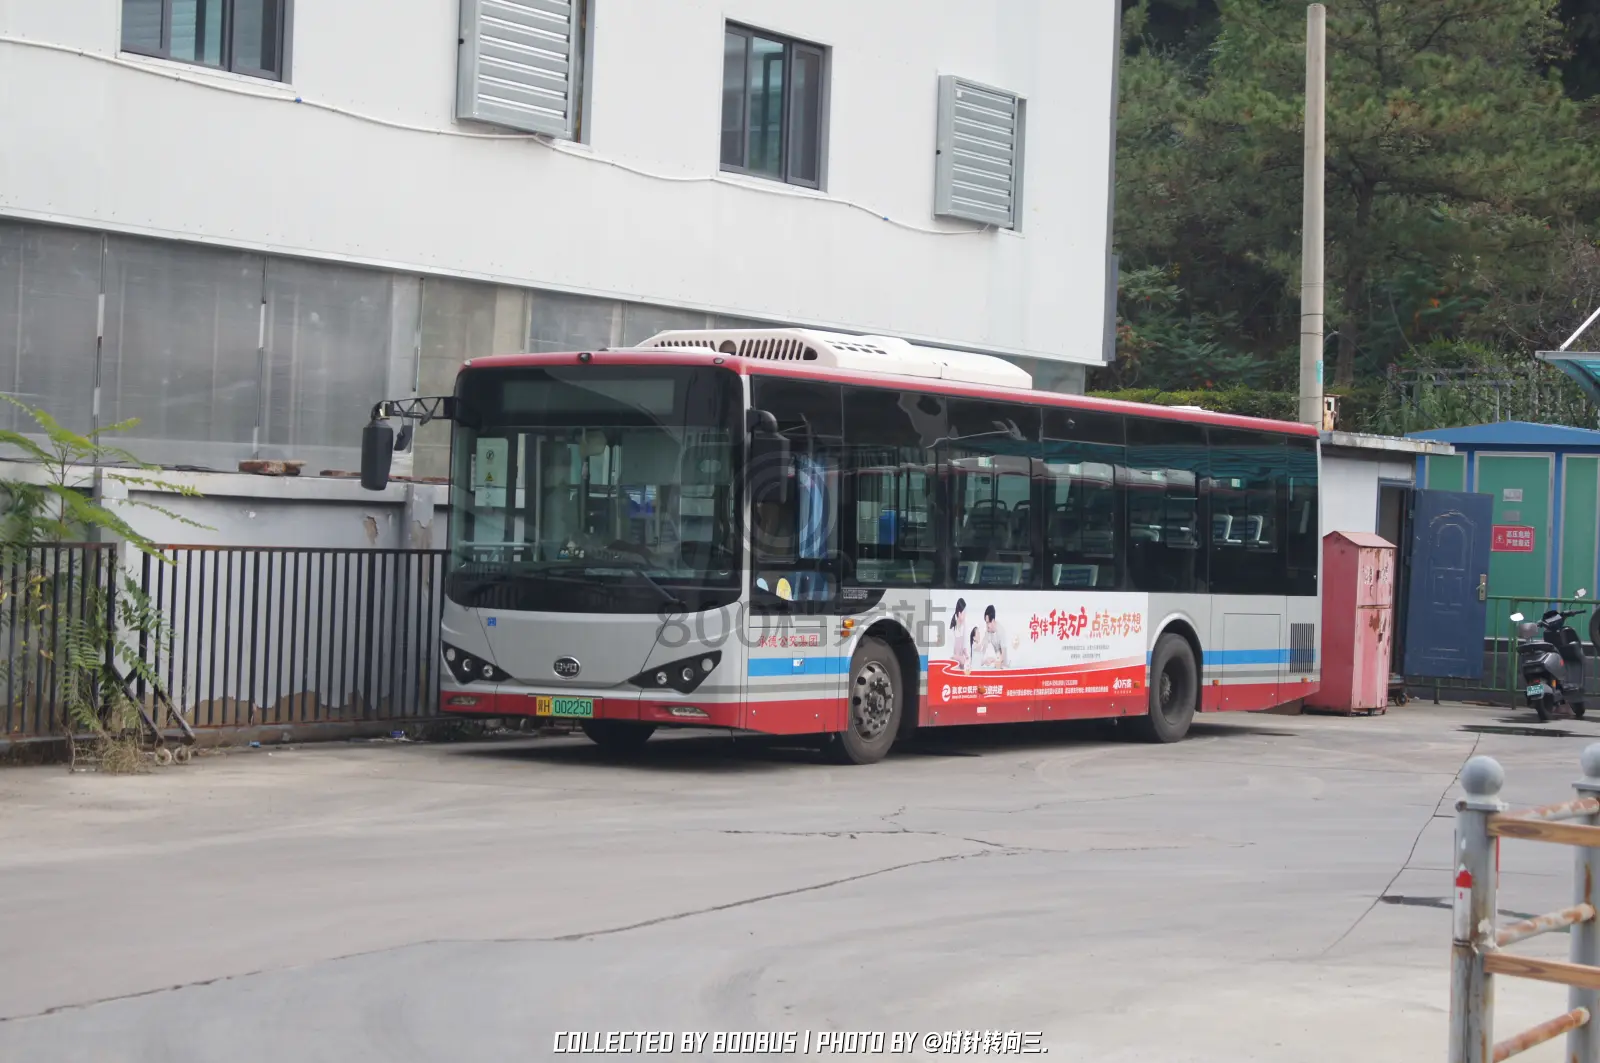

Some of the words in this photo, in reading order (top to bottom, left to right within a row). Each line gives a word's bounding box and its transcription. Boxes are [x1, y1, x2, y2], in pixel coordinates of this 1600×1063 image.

[1029, 606, 1088, 643] 常伴千家万户
[758, 634, 819, 648] 承德公交集团
[555, 662, 578, 672] BYD
